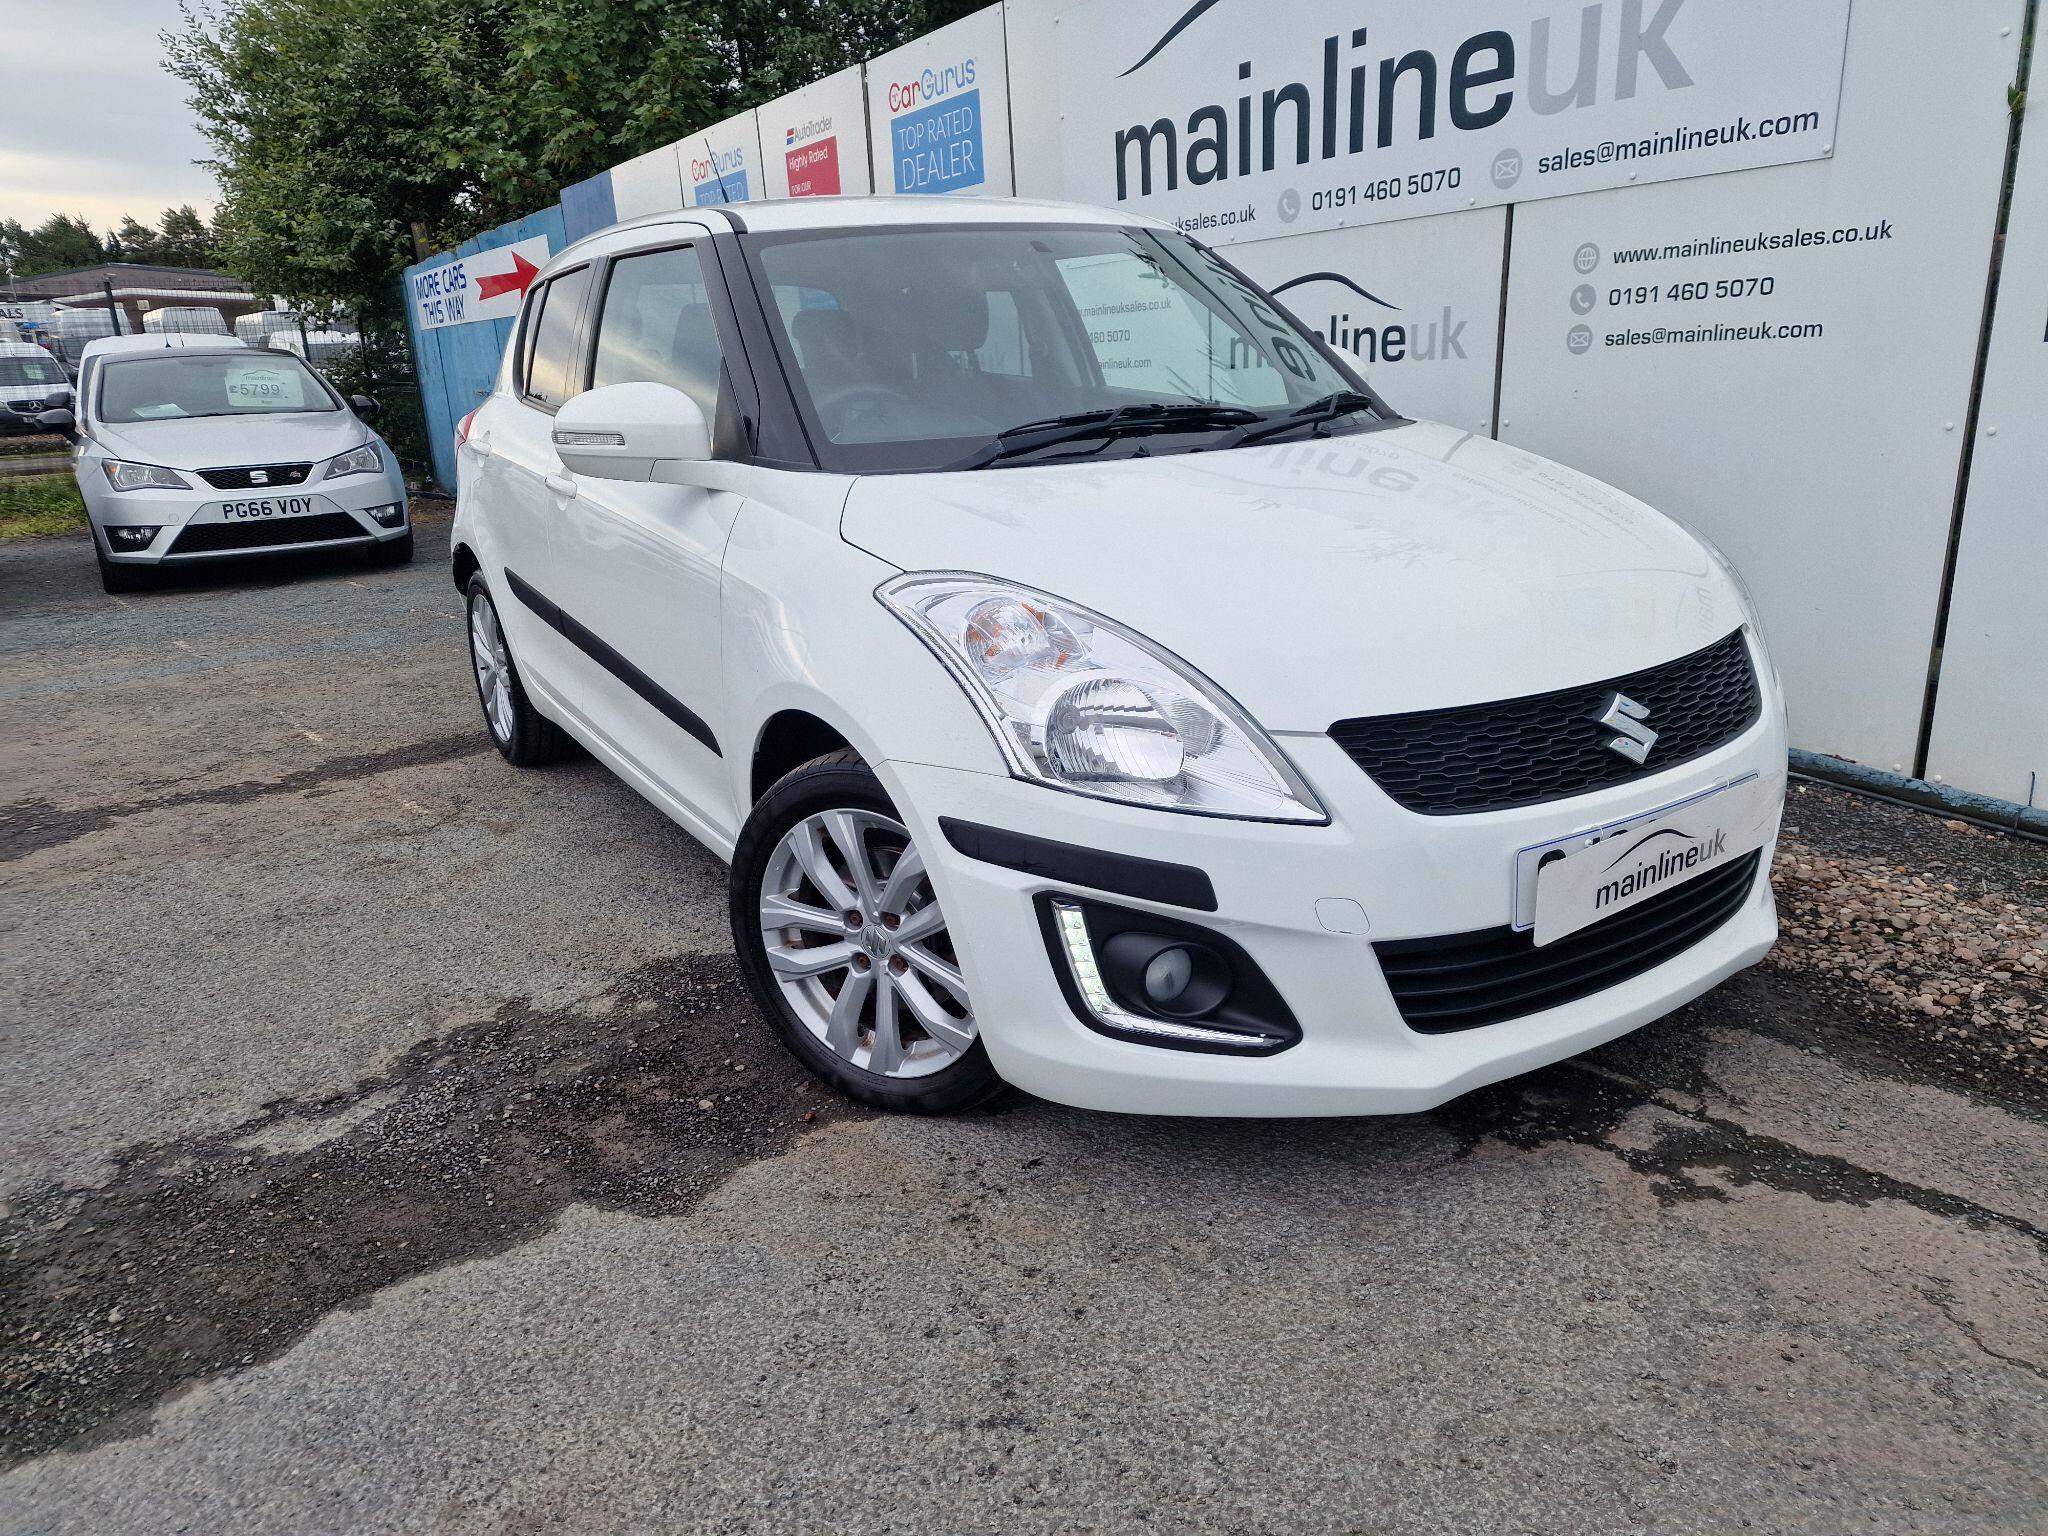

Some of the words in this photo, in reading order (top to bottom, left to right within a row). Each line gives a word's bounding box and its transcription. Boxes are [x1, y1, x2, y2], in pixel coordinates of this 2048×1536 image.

[889, 59, 976, 112] CarGurus
[1115, 0, 1694, 200] mainlineuk
[794, 116, 833, 142] AutoTrader
[898, 123, 924, 152] TOP
[927, 106, 973, 143] RATED
[1538, 111, 1819, 173] sales@mainlineuk.com
[789, 154, 807, 171] Highly
[808, 146, 828, 163] Rated
[903, 140, 975, 189] DEALER
[1312, 186, 1356, 211] 0191
[1363, 177, 1401, 201] 460
[1407, 167, 1461, 195] 5070
[1613, 219, 1893, 264] www.mainlineuksales.co.uk
[415, 271, 441, 300] MORE
[442, 263, 467, 293] CARS
[1609, 286, 1659, 306] 0191
[1666, 282, 1709, 302] 460
[1715, 276, 1775, 299] 5070
[423, 299, 445, 325] THIS
[445, 294, 465, 321] WAY
[1605, 321, 1823, 347] sales@mainlineuk.com
[222, 500, 273, 519] PG66
[277, 497, 311, 514] VOY
[1595, 828, 1727, 909] mainlineuk
